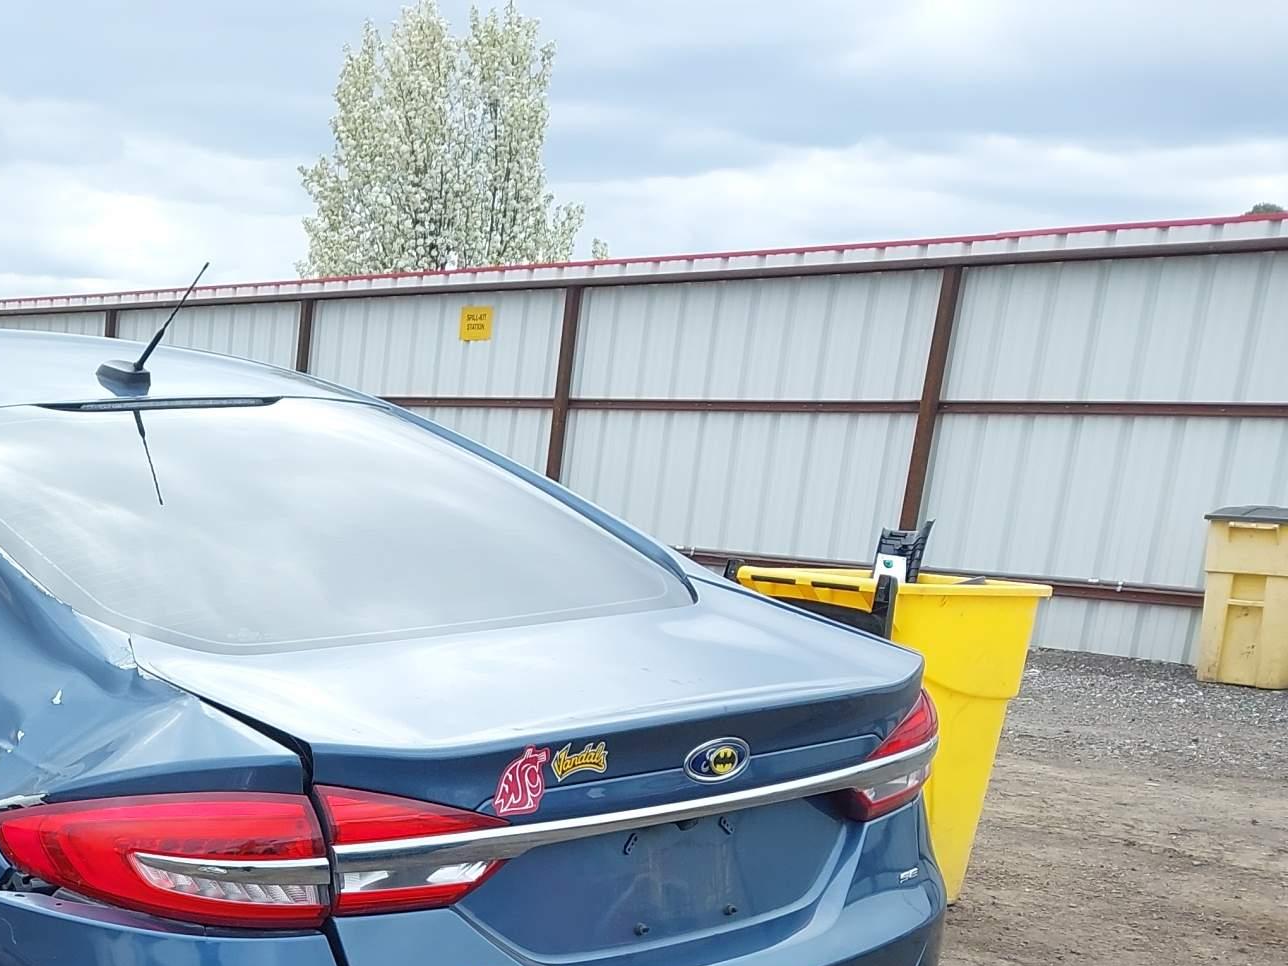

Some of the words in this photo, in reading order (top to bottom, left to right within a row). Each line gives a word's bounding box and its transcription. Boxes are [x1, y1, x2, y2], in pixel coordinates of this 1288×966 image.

[466, 323, 485, 331] STATION
[552, 742, 608, 781] Vandals
[899, 867, 919, 884] SE
